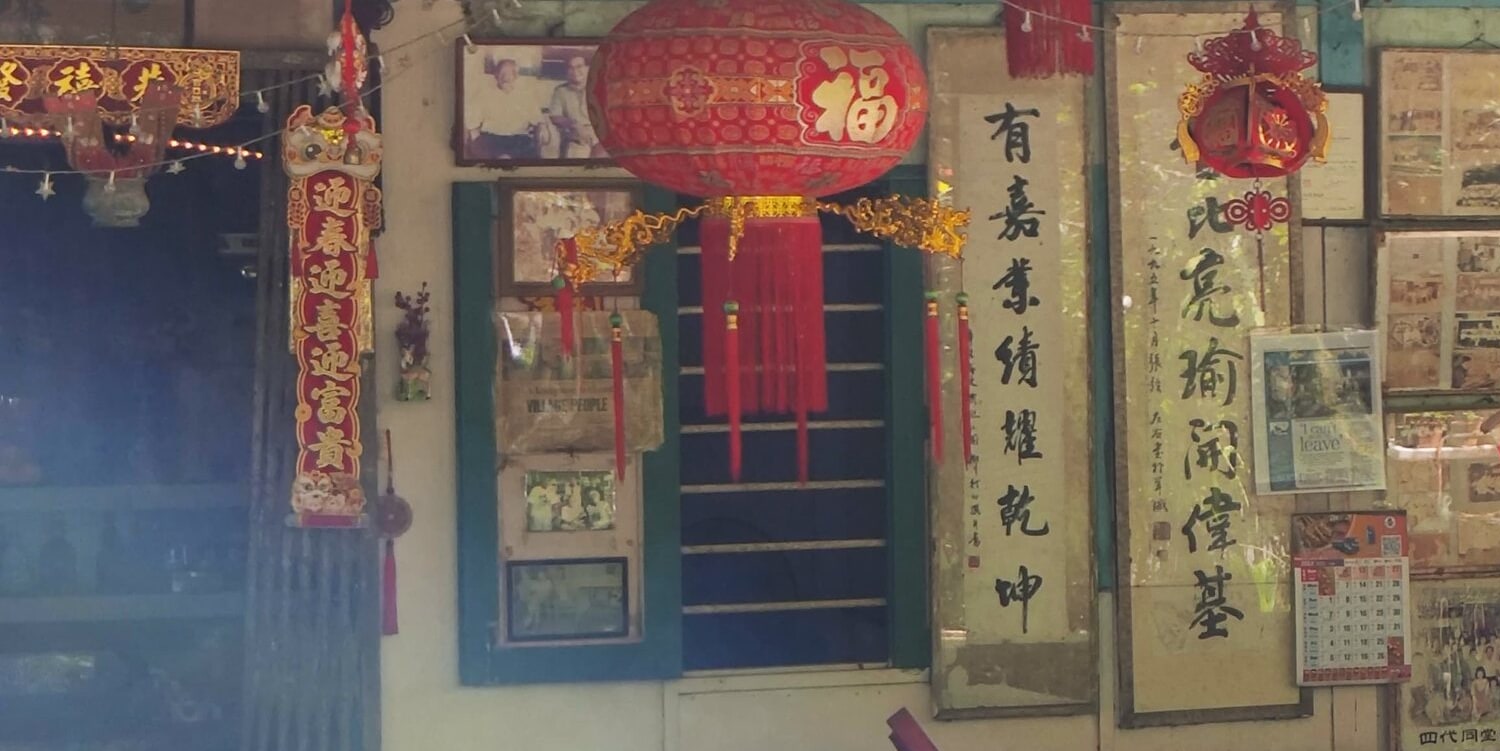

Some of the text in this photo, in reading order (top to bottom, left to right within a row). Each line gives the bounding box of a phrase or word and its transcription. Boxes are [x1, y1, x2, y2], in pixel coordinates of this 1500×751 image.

[812, 45, 898, 144] 福
[303, 176, 357, 470] 迎春迎喜迎富貴
[1170, 138, 1245, 640] 比亮瑜開偉基
